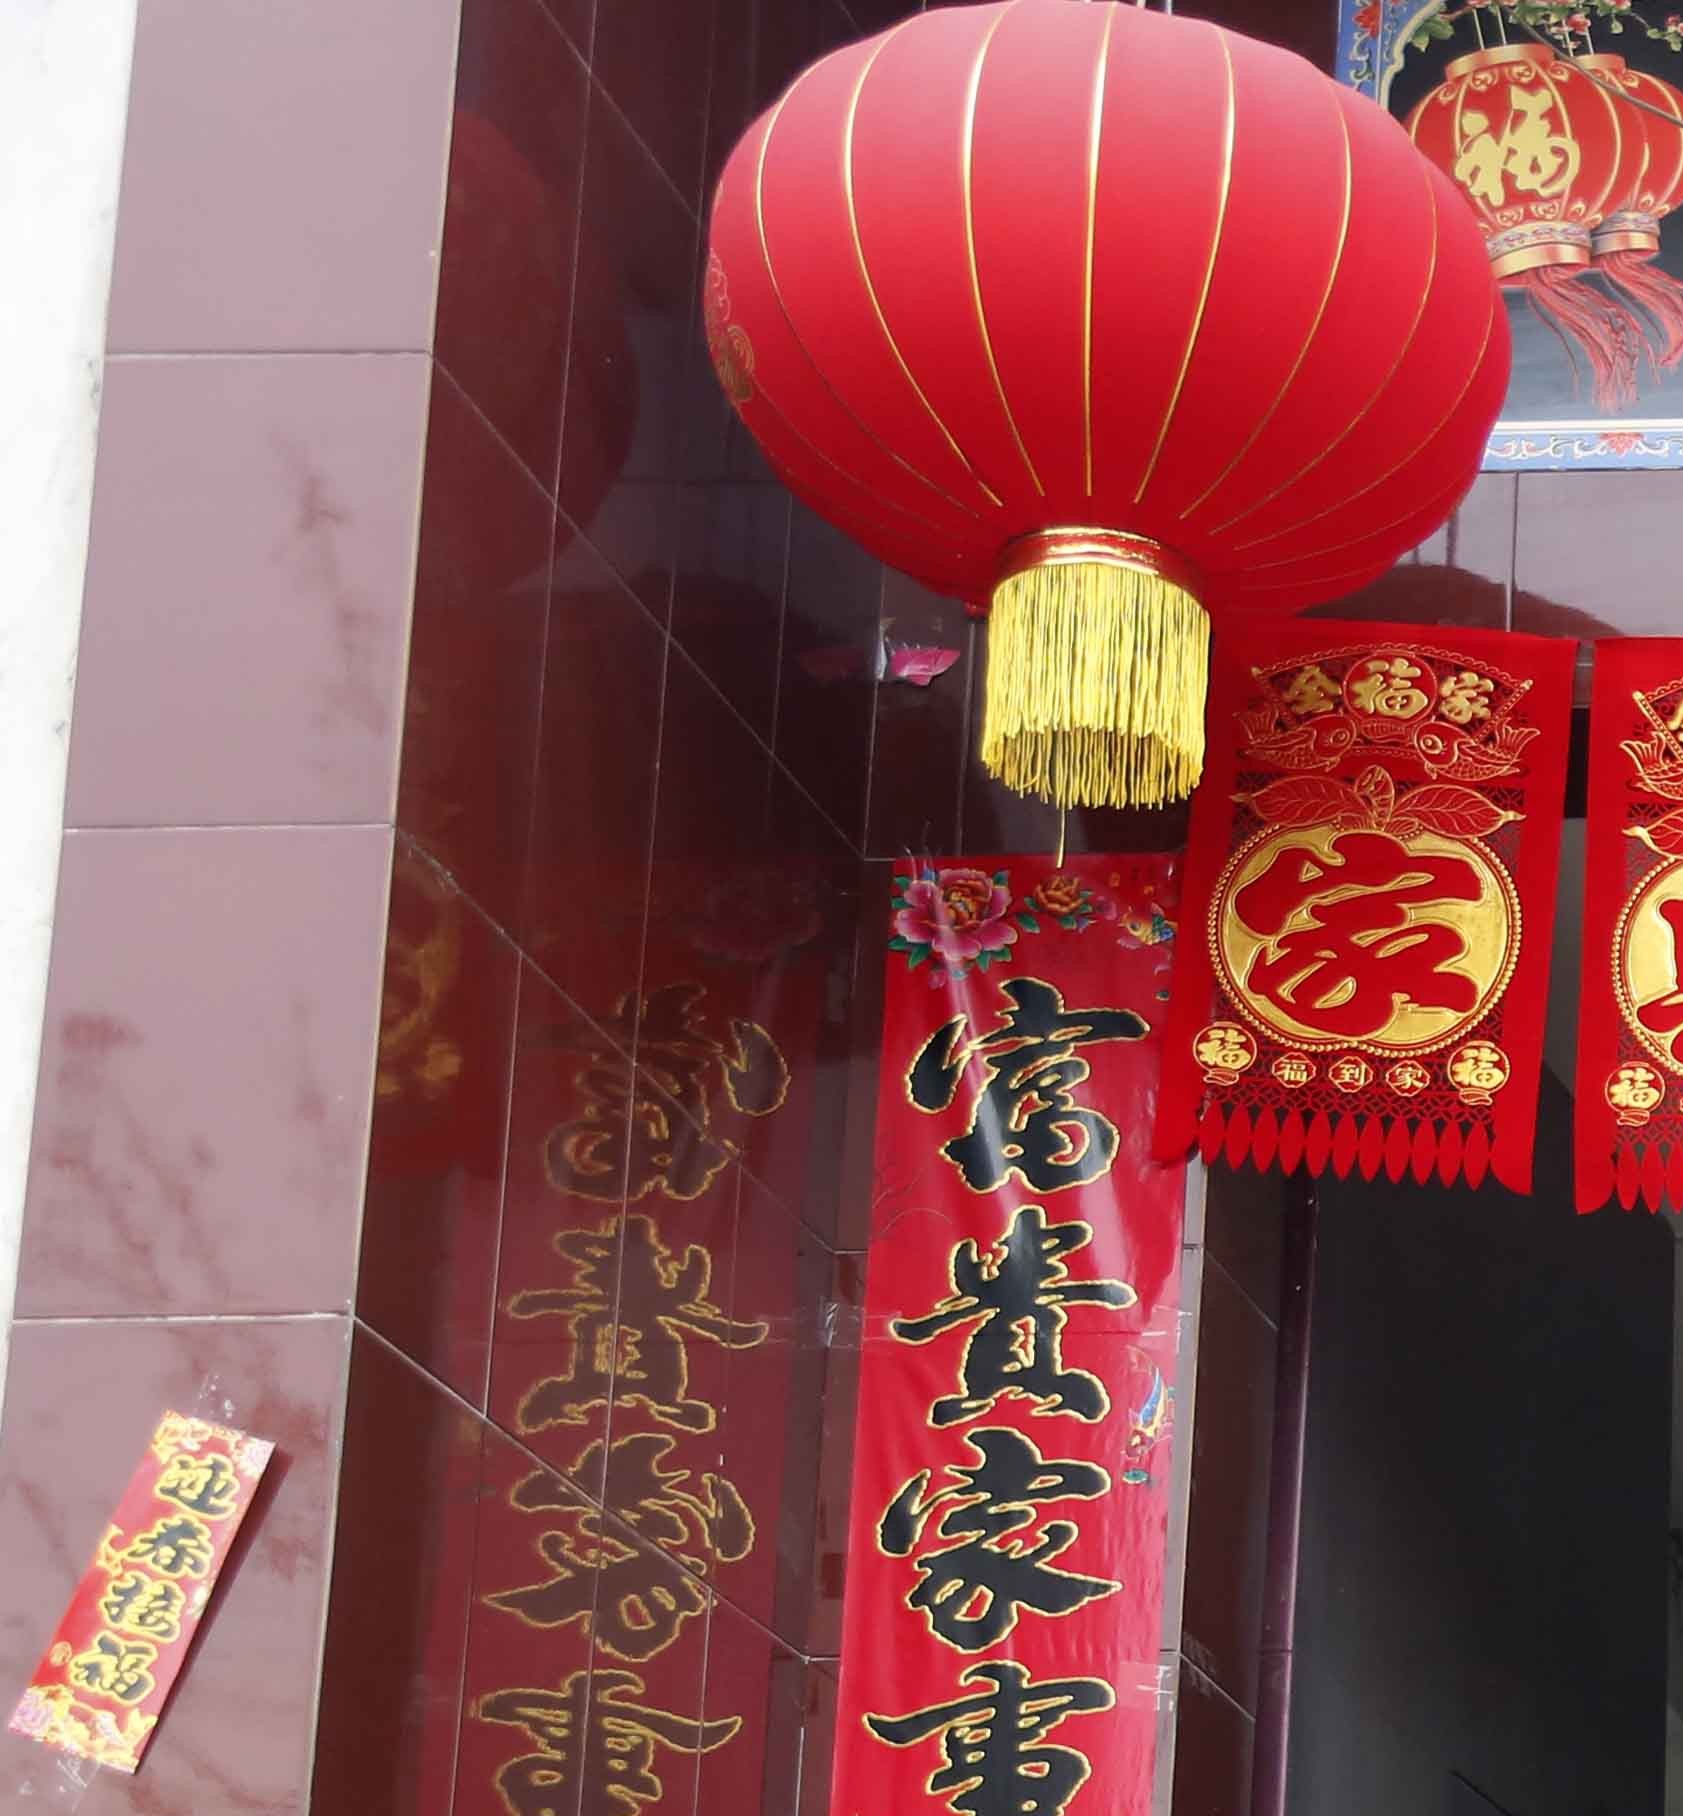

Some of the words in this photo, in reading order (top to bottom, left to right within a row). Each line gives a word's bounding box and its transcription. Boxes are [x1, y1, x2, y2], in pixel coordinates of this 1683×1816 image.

[1453, 84, 1580, 206] 福
[1236, 831, 1484, 1038] 家
[1199, 1027, 1251, 1070] 福
[1451, 1045, 1505, 1090] 福
[1610, 1067, 1661, 1111] 福
[68, 1453, 241, 1706] 迎春接福
